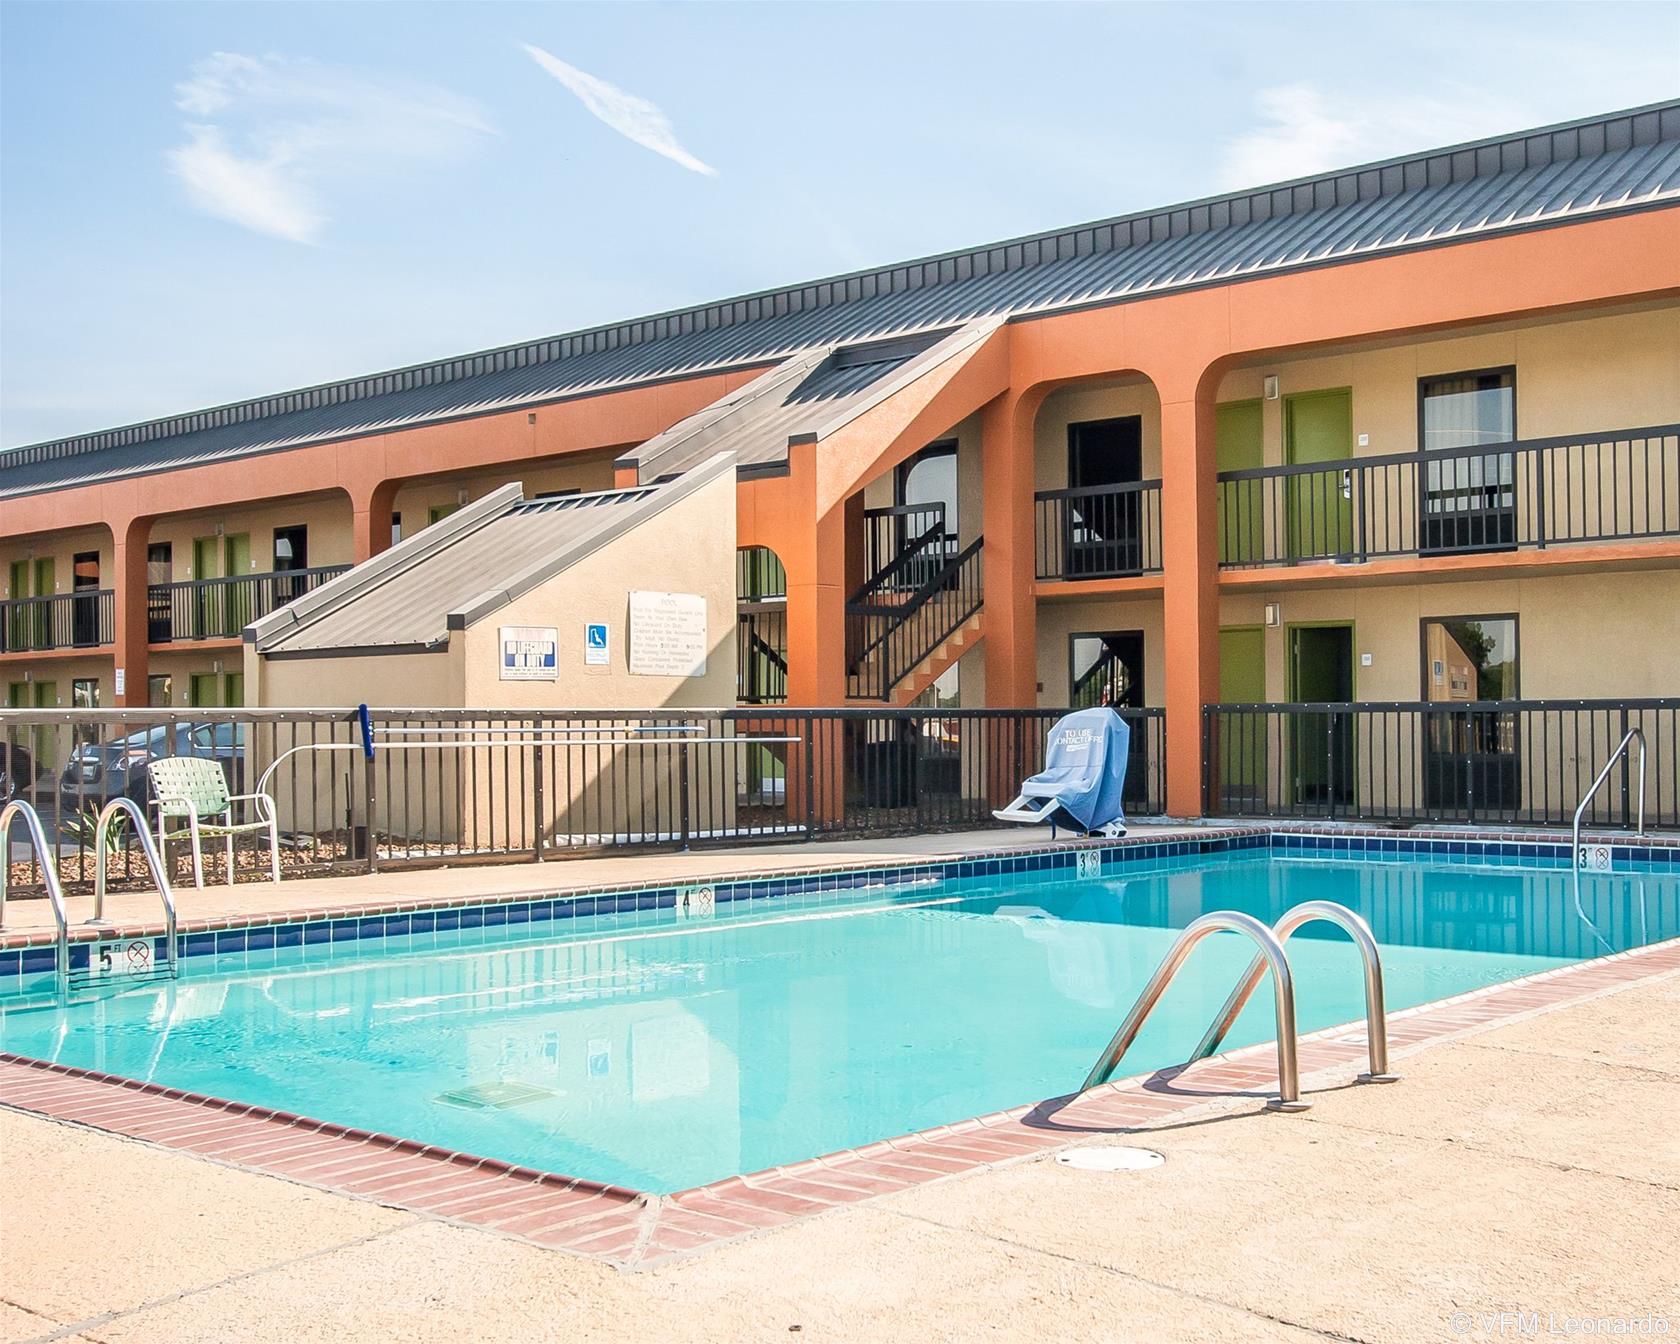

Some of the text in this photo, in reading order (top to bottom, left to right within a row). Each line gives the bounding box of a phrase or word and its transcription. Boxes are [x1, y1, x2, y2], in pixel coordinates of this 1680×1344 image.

[1065, 729, 1076, 738] TO
[1580, 847, 1587, 868] 3
[99, 945, 112, 973] 5
